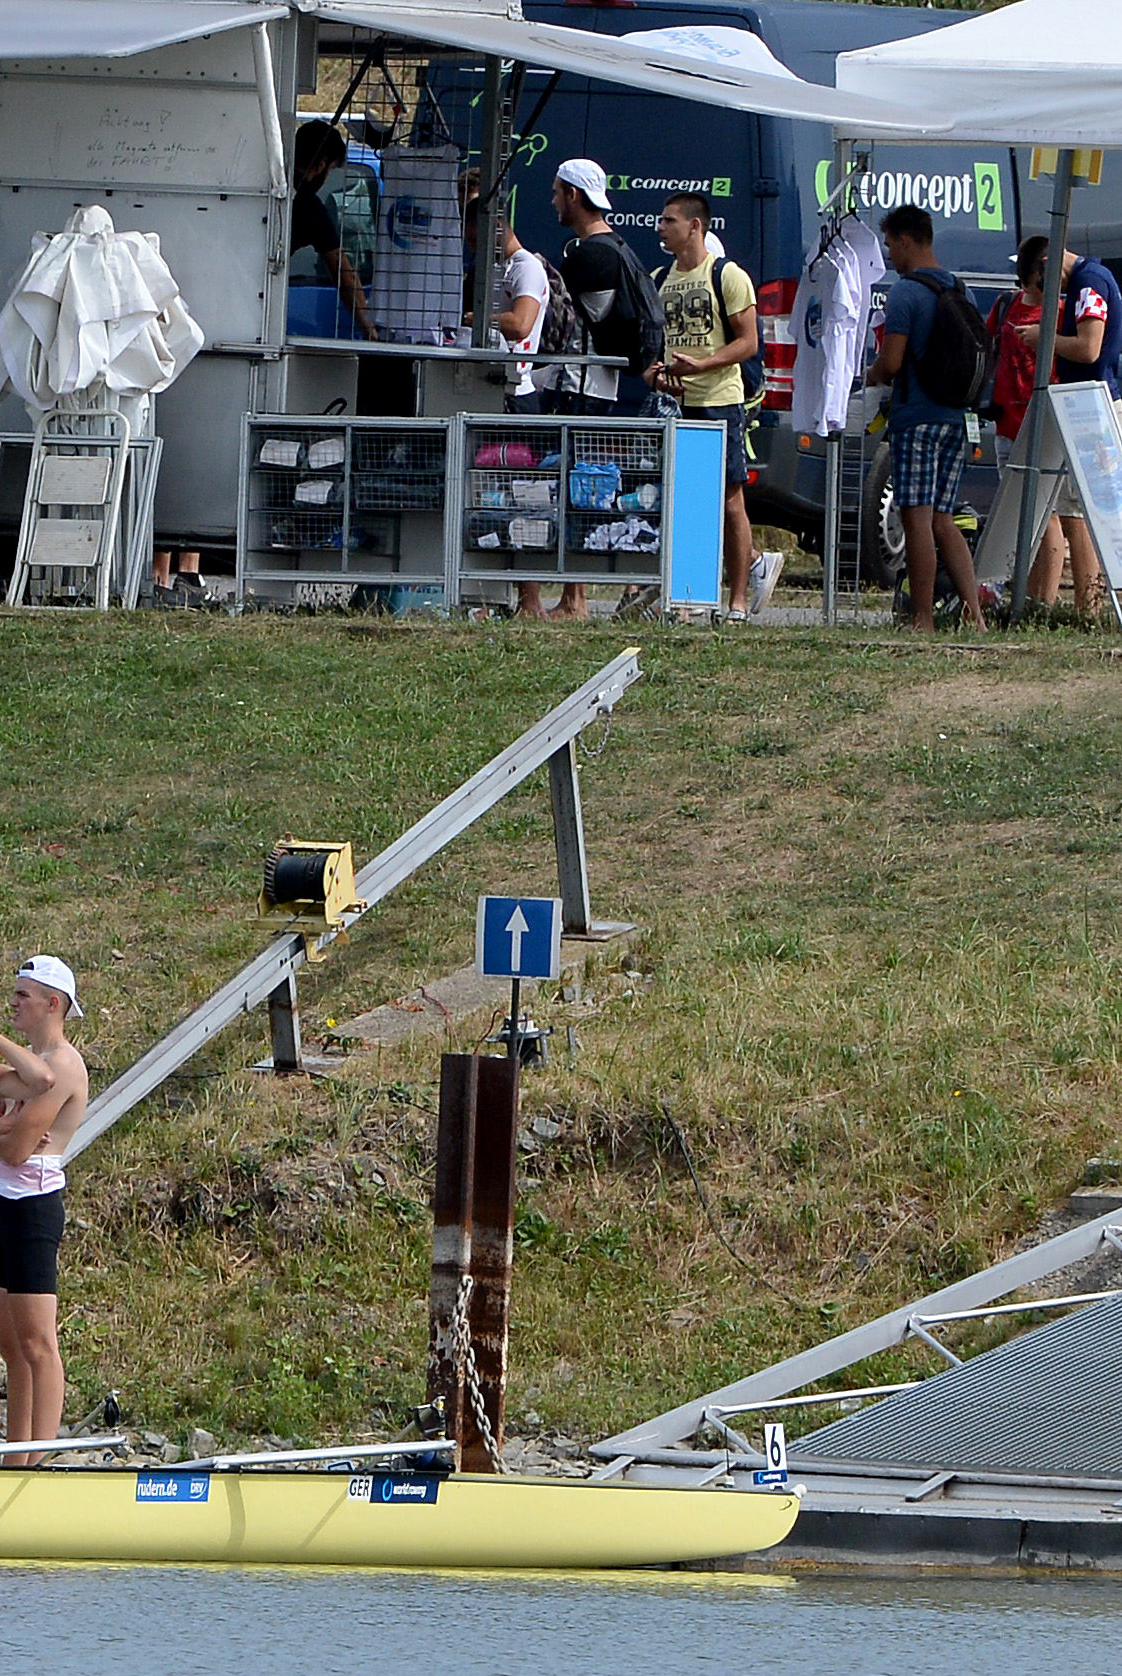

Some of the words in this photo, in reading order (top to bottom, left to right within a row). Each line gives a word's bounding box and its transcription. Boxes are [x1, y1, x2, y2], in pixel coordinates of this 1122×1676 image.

[631, 177, 710, 192] concept
[860, 171, 974, 218] concept
[770, 1426, 781, 1467] 6
[137, 1478, 178, 1497] rudern.de
[349, 1478, 370, 1497] GER
